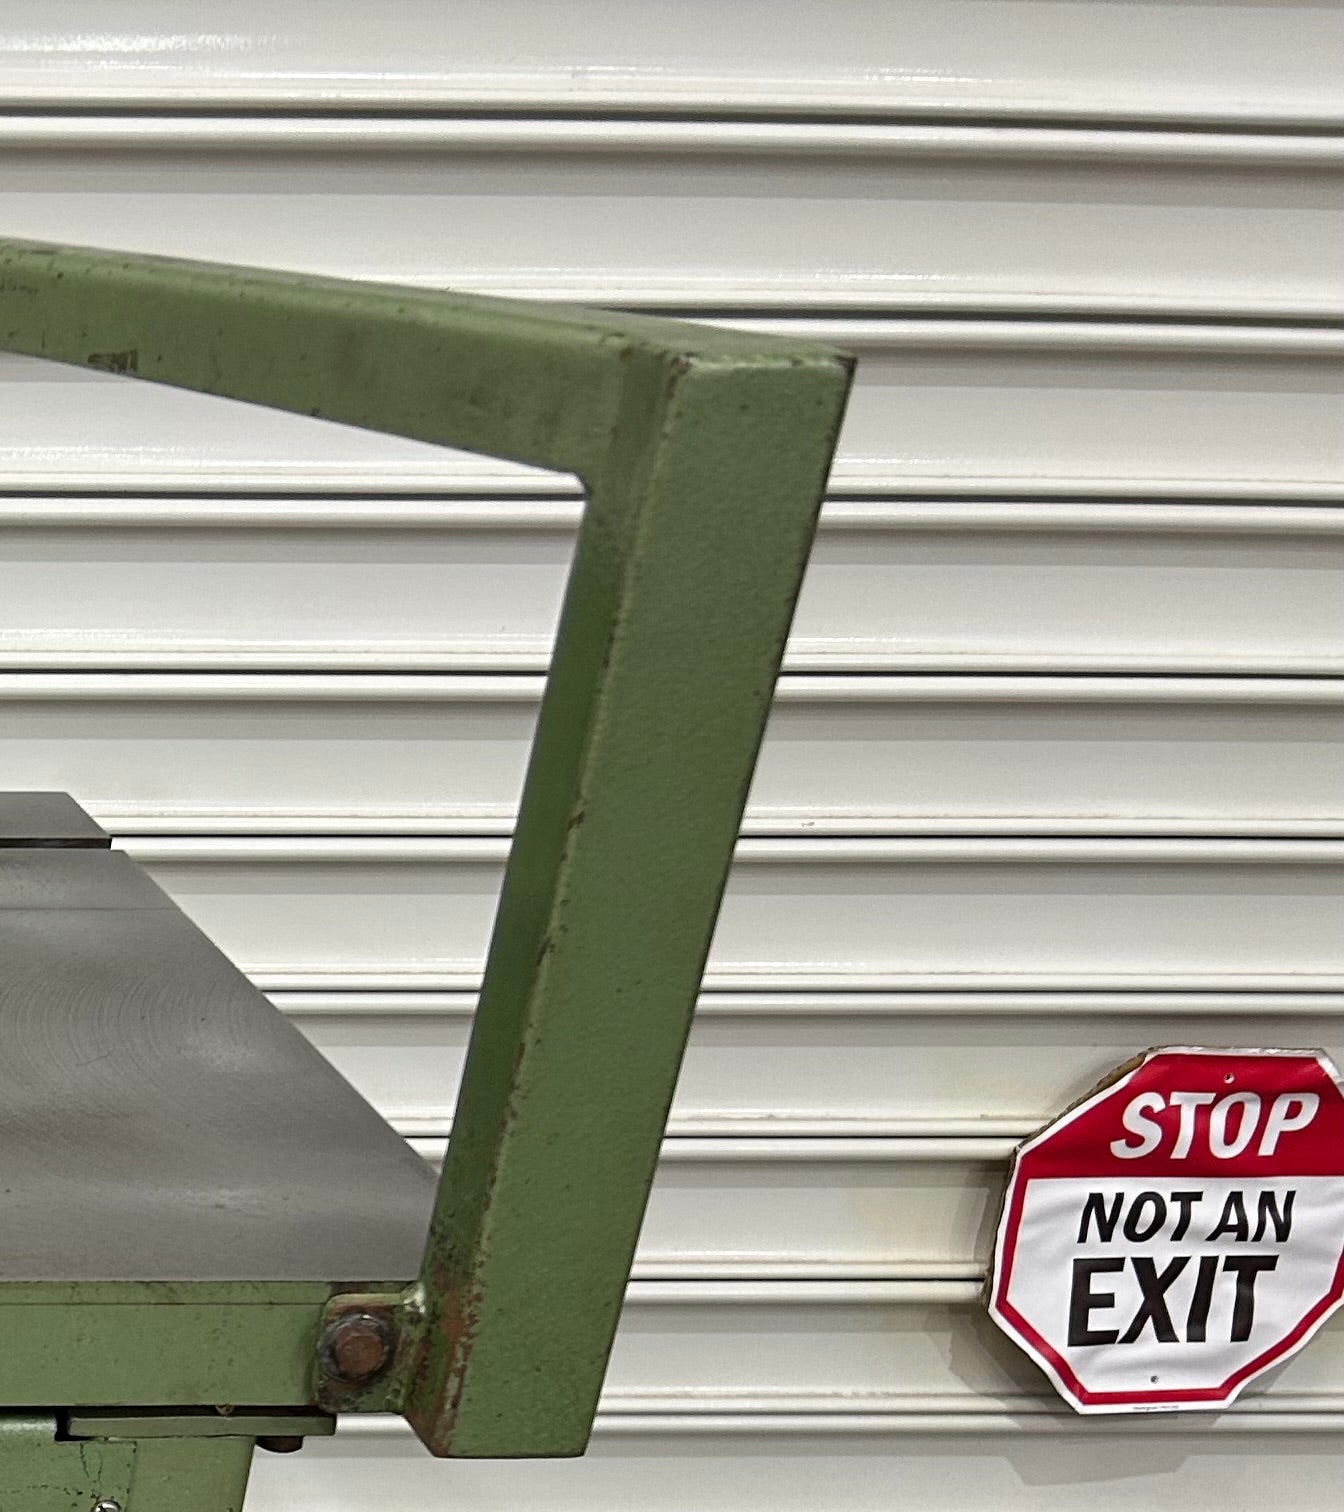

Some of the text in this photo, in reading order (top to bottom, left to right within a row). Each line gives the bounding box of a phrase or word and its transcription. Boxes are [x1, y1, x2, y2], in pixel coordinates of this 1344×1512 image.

[1110, 1092, 1320, 1160] STOP
[1077, 1190, 1296, 1244] NOT AN
[1067, 1255, 1279, 1347] EXIT
